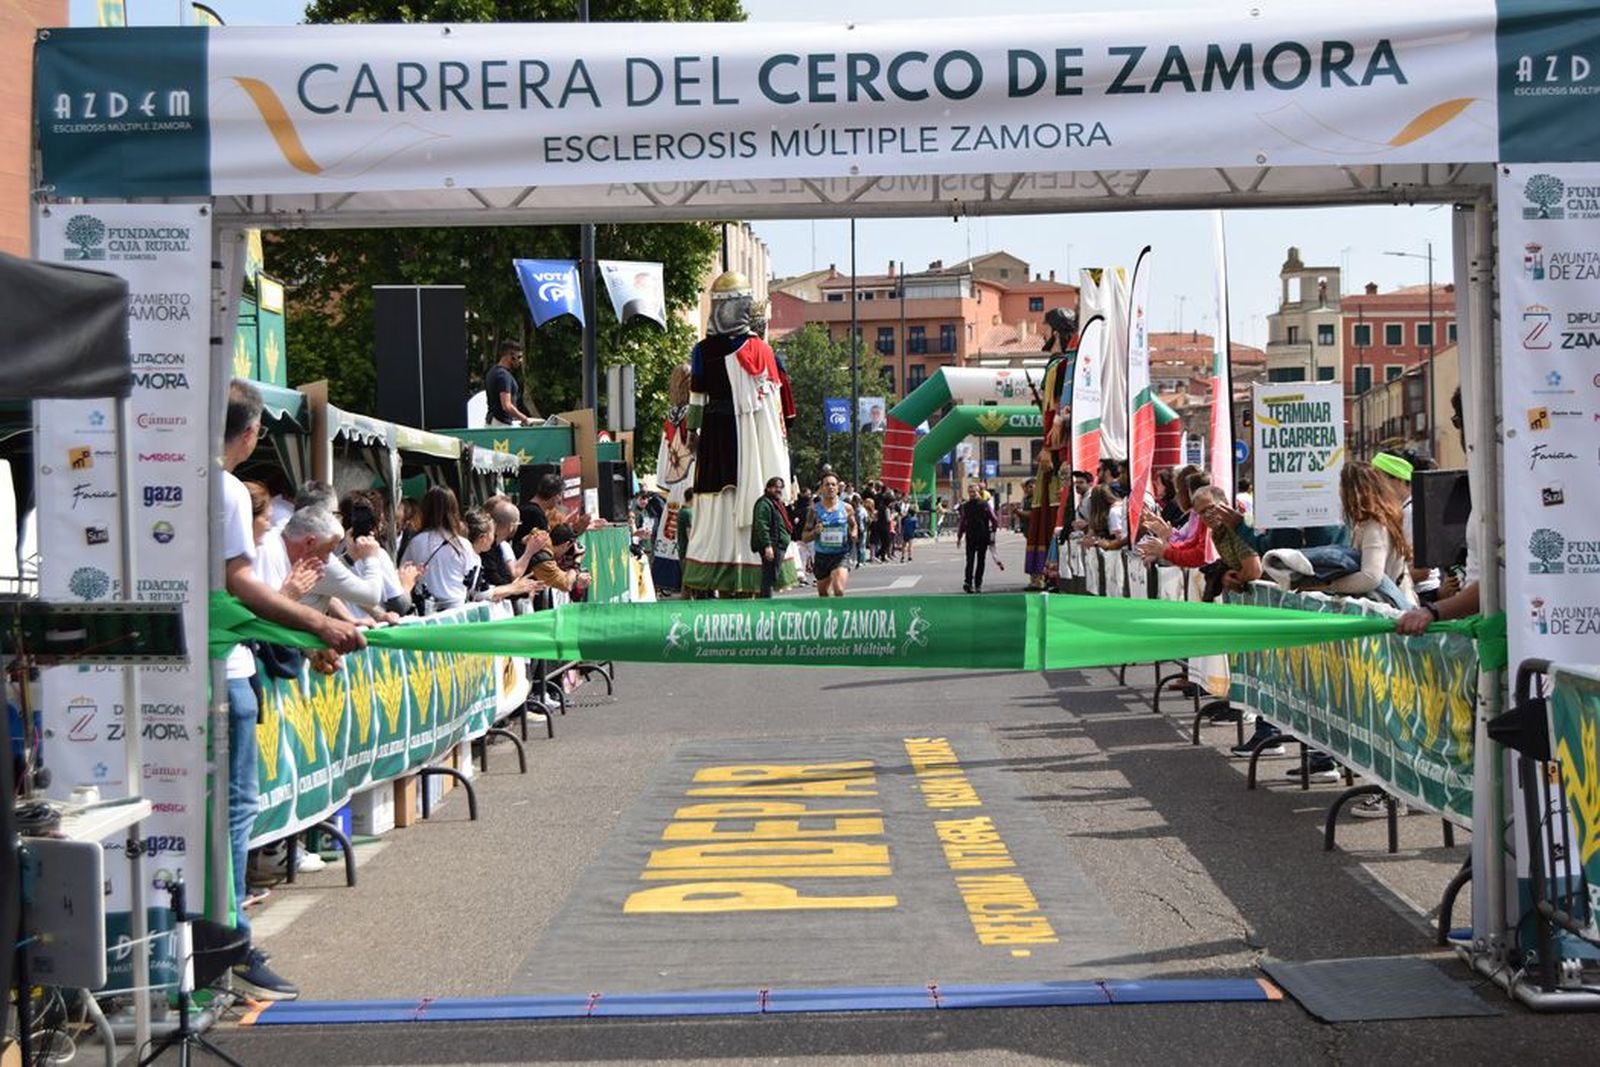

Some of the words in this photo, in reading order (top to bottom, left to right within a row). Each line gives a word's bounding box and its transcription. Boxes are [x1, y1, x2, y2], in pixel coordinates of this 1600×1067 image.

[297, 58, 603, 114] CARRERA
[626, 56, 739, 106] DEL
[758, 49, 984, 104] CERCO
[1007, 47, 1084, 98] DE
[1105, 39, 1409, 95] ZAMORA
[53, 123, 106, 133] ESCLEROSIS
[544, 130, 757, 163] ESCLEROSIS
[771, 123, 938, 158] MÚLTIPLE
[950, 121, 1112, 153] ZAMORA
[108, 227, 190, 239] FUNDACION
[108, 240, 141, 251] CAJA
[144, 240, 190, 252] RURAL
[1550, 265, 1570, 280] DE
[129, 306, 190, 320] AMORA
[131, 373, 190, 389] MORA
[1267, 401, 1331, 424] TERMINAR
[1261, 428, 1278, 449] LA
[1280, 426, 1338, 449] CARRERA
[1268, 452, 1285, 473] EN
[143, 485, 184, 508] gaza
[694, 613, 751, 642] CARRERA
[756, 611, 775, 640] del
[778, 610, 821, 640] CERCO
[824, 609, 838, 639] de
[841, 609, 897, 639] ZAMORA
[1550, 619, 1570, 634] DE
[695, 646, 736, 657] Zamora
[739, 647, 767, 657] cerca
[770, 645, 784, 656] de
[786, 645, 796, 656] la
[799, 643, 850, 656] Esclerosis
[852, 642, 896, 657] Múltiple
[147, 836, 185, 857] gaza
